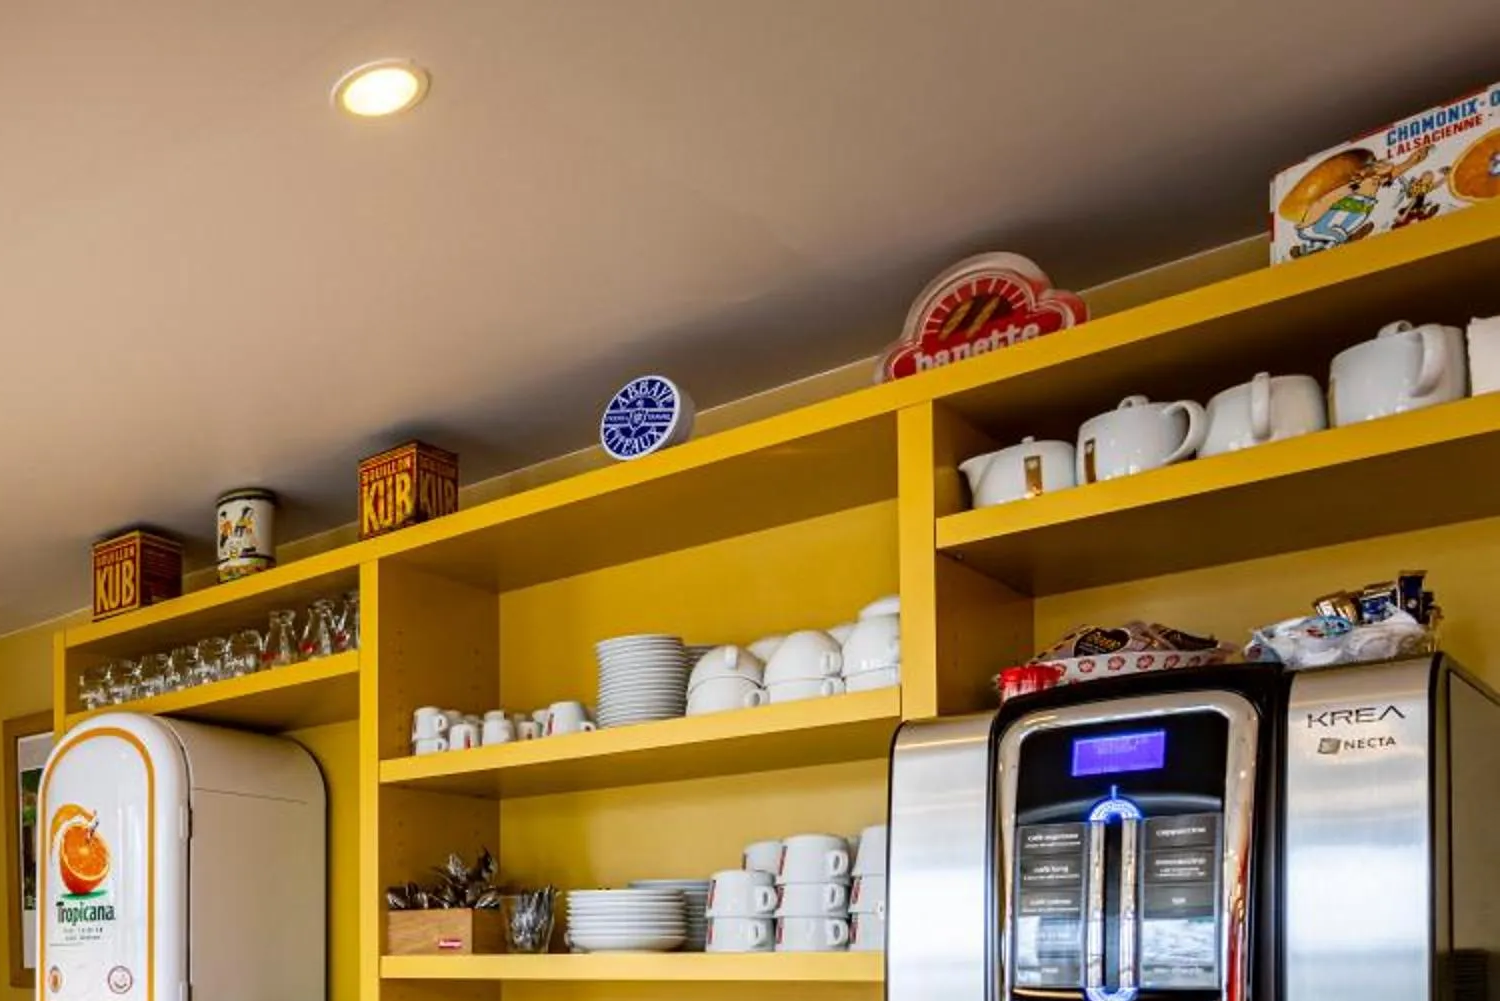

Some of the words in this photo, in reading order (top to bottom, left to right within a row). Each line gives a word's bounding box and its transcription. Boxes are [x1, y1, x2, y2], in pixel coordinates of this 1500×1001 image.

[1387, 113, 1483, 160] L'ALSACIENNE
[362, 472, 411, 535] KUB
[95, 559, 135, 613] KUB
[1306, 704, 1405, 729] KREA
[1343, 736, 1397, 750] NECTA
[56, 901, 116, 927] Tropicana
